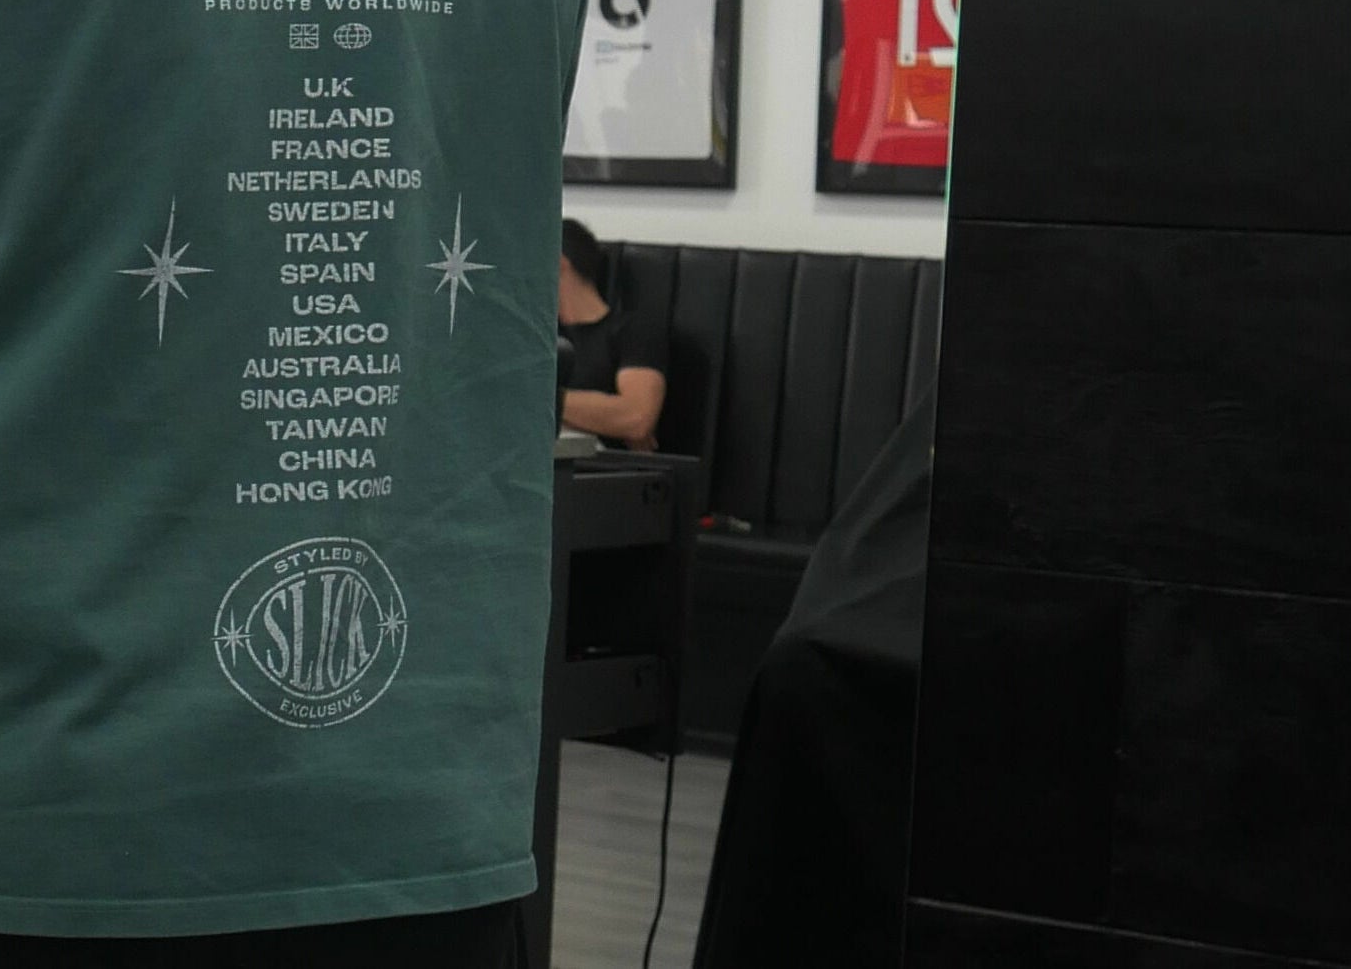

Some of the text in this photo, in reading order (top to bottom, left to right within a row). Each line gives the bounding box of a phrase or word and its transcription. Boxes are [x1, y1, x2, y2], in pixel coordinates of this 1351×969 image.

[303, 77, 355, 99] U.K
[269, 107, 396, 130] IRELAND
[271, 138, 392, 161] FRANCE
[227, 168, 423, 193] NETHERLANDS
[268, 200, 396, 223] SWEDEN
[285, 231, 369, 254] ITALY
[280, 262, 376, 286] SPAIN
[293, 294, 362, 317] USA
[269, 323, 390, 348] MEXICO
[242, 354, 402, 380] AUSTRALIA
[240, 385, 402, 411] SINGAPORE
[266, 417, 388, 442] TAIWAN
[279, 449, 377, 472] CHINA
[236, 476, 393, 505] HONG KONG
[274, 547, 369, 574] STYLED BY
[263, 574, 371, 692] SLICK
[280, 688, 363, 719] EXCLUSIVE
